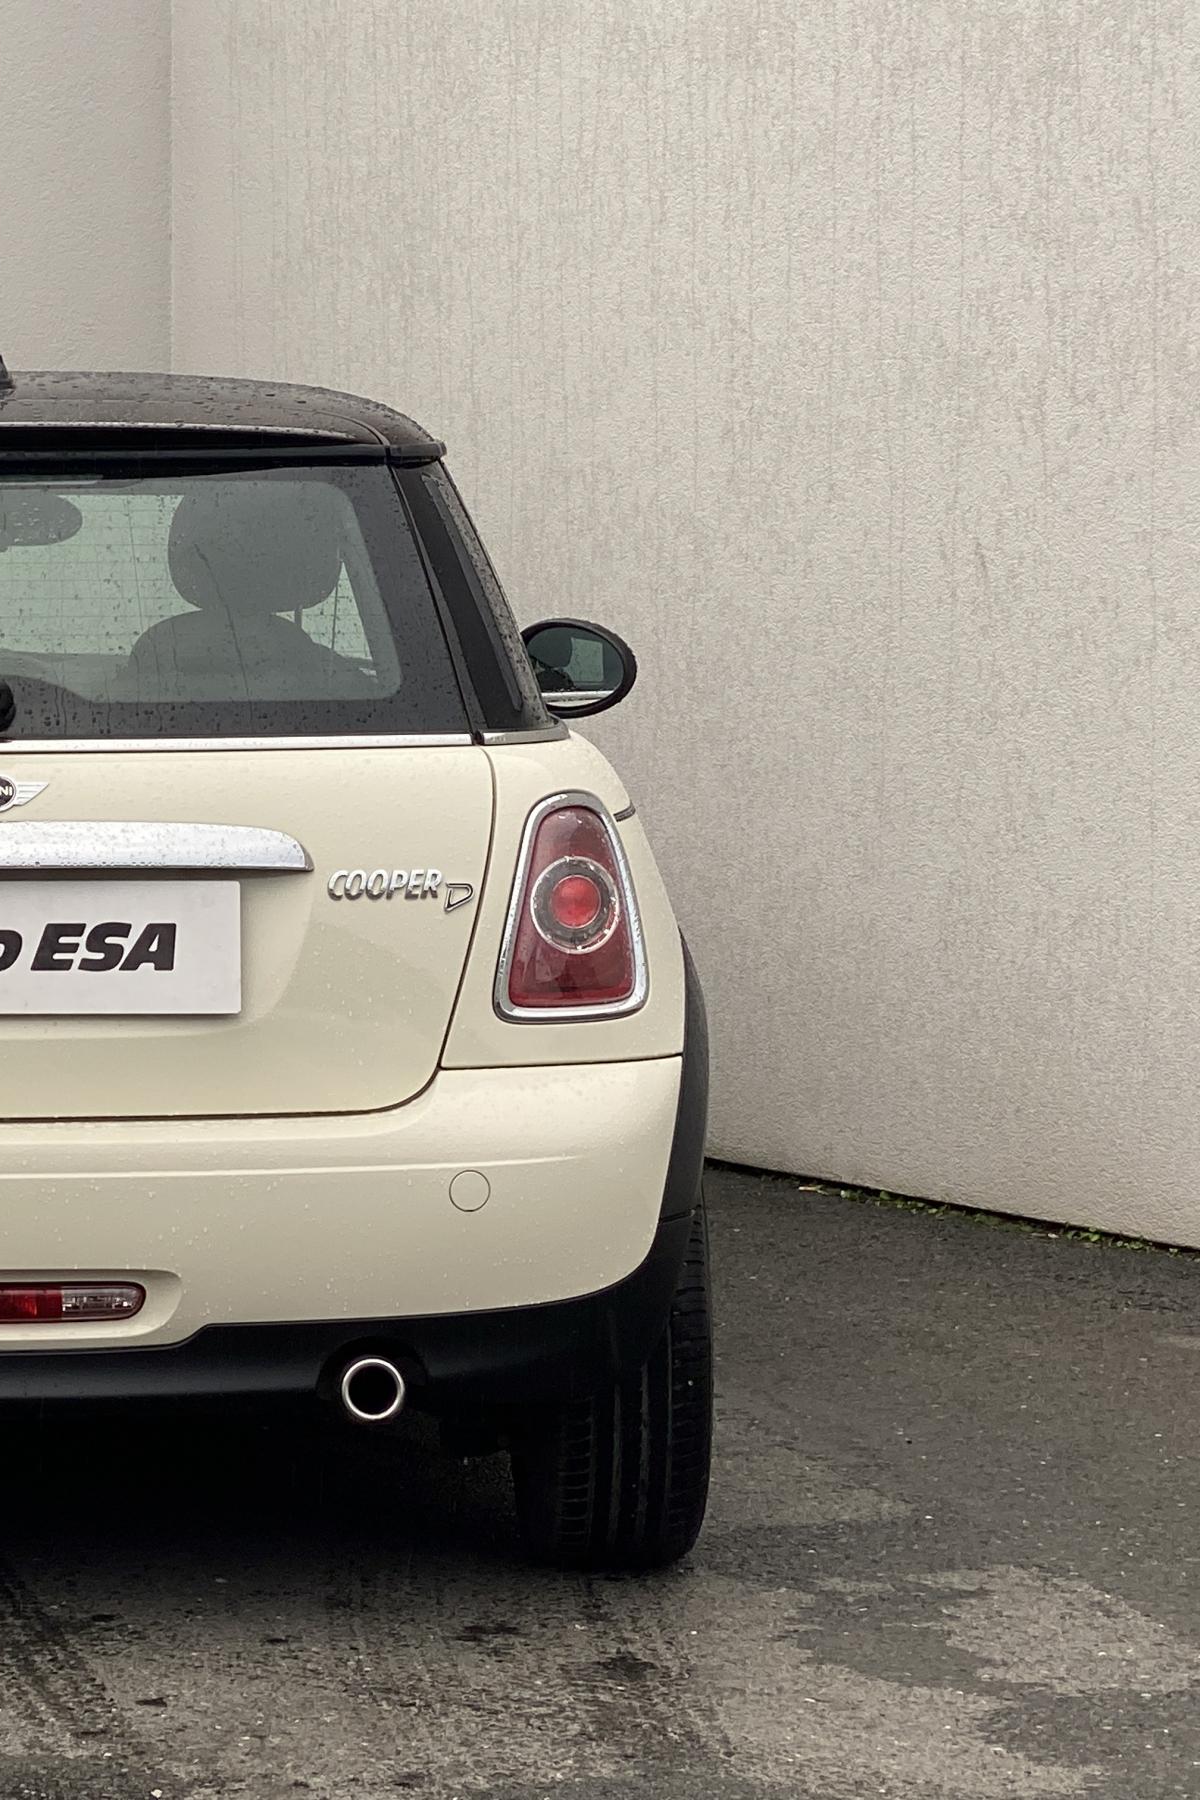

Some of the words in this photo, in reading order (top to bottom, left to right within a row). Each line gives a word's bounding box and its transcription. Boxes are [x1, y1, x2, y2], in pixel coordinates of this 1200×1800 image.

[328, 869, 443, 900] COOPER
[444, 883, 474, 913] D
[30, 922, 177, 972] ESA
